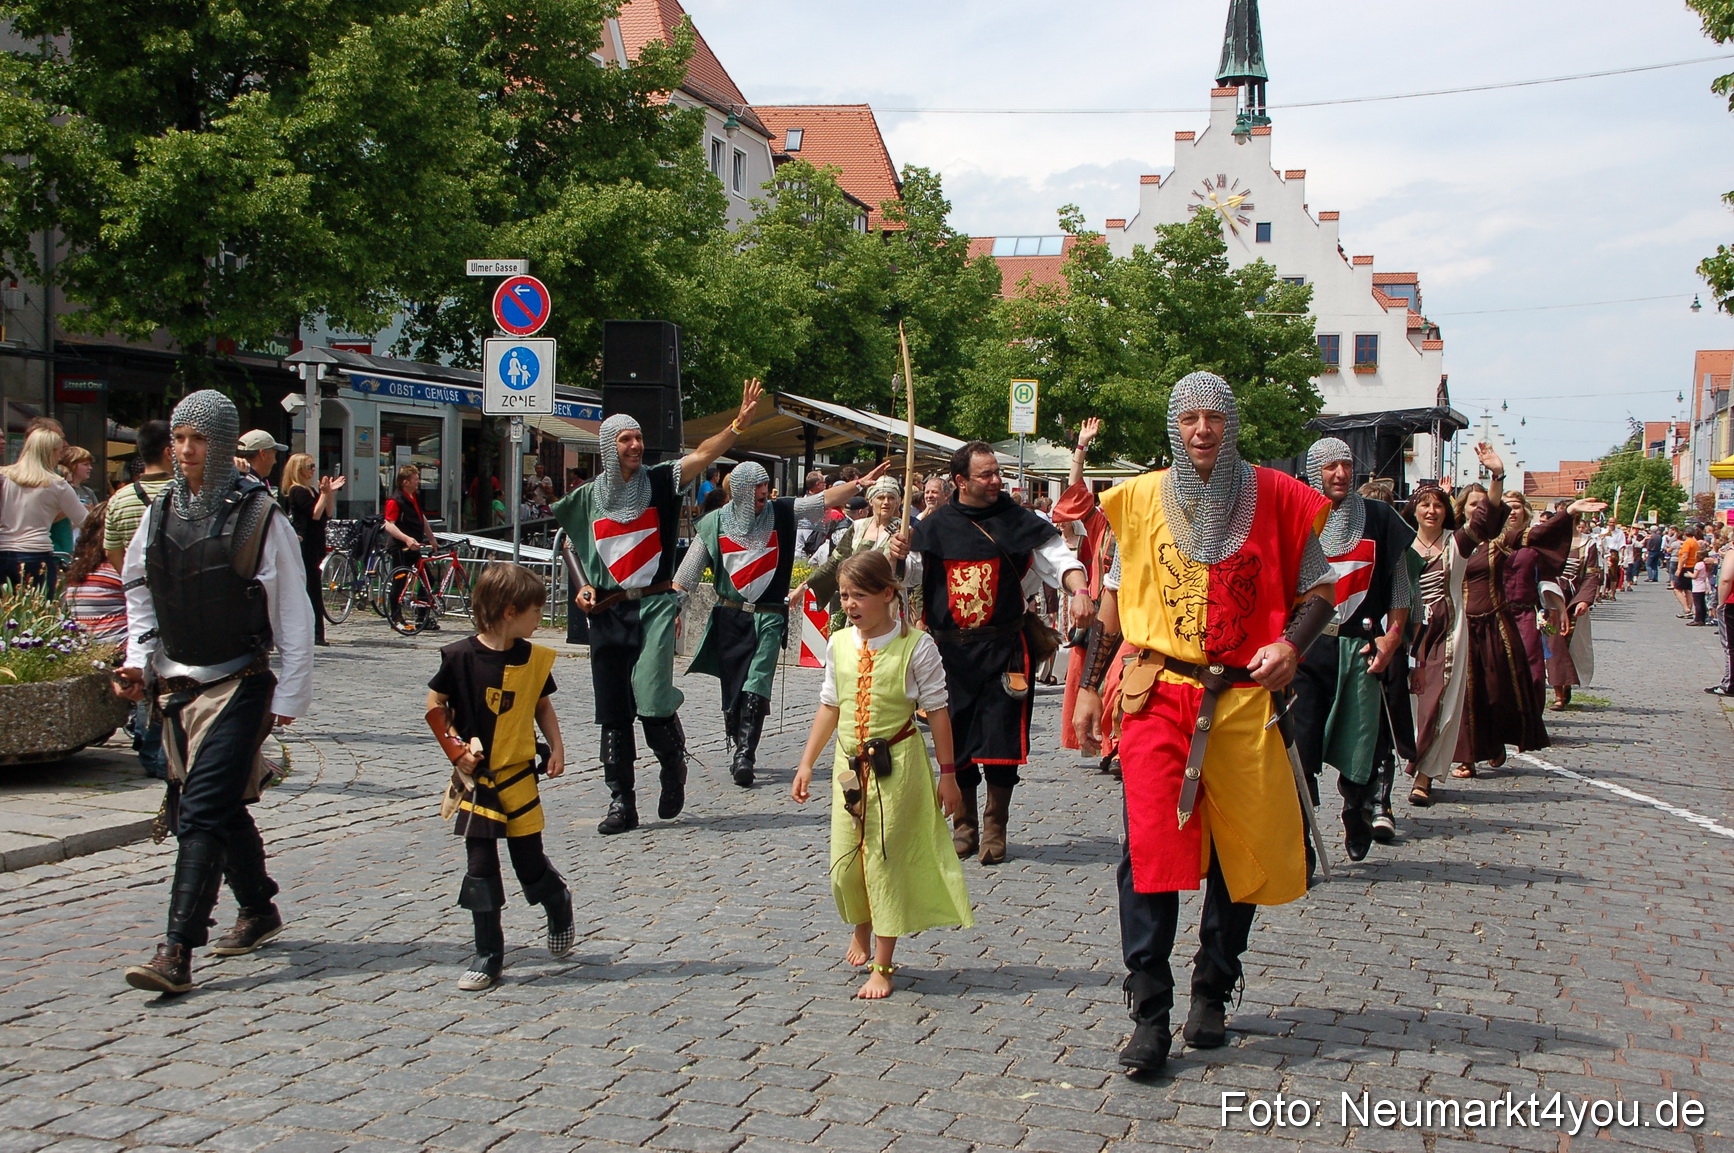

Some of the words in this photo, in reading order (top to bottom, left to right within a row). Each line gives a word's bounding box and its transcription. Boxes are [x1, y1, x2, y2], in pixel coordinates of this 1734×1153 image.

[471, 263, 493, 272] Ulmer
[495, 263, 518, 272] Gasse
[269, 341, 289, 356] One
[64, 381, 87, 389] Street
[87, 381, 103, 389] One
[389, 382, 415, 396] OBST
[424, 387, 460, 402] GEMÜSE
[1019, 388, 1029, 399] H
